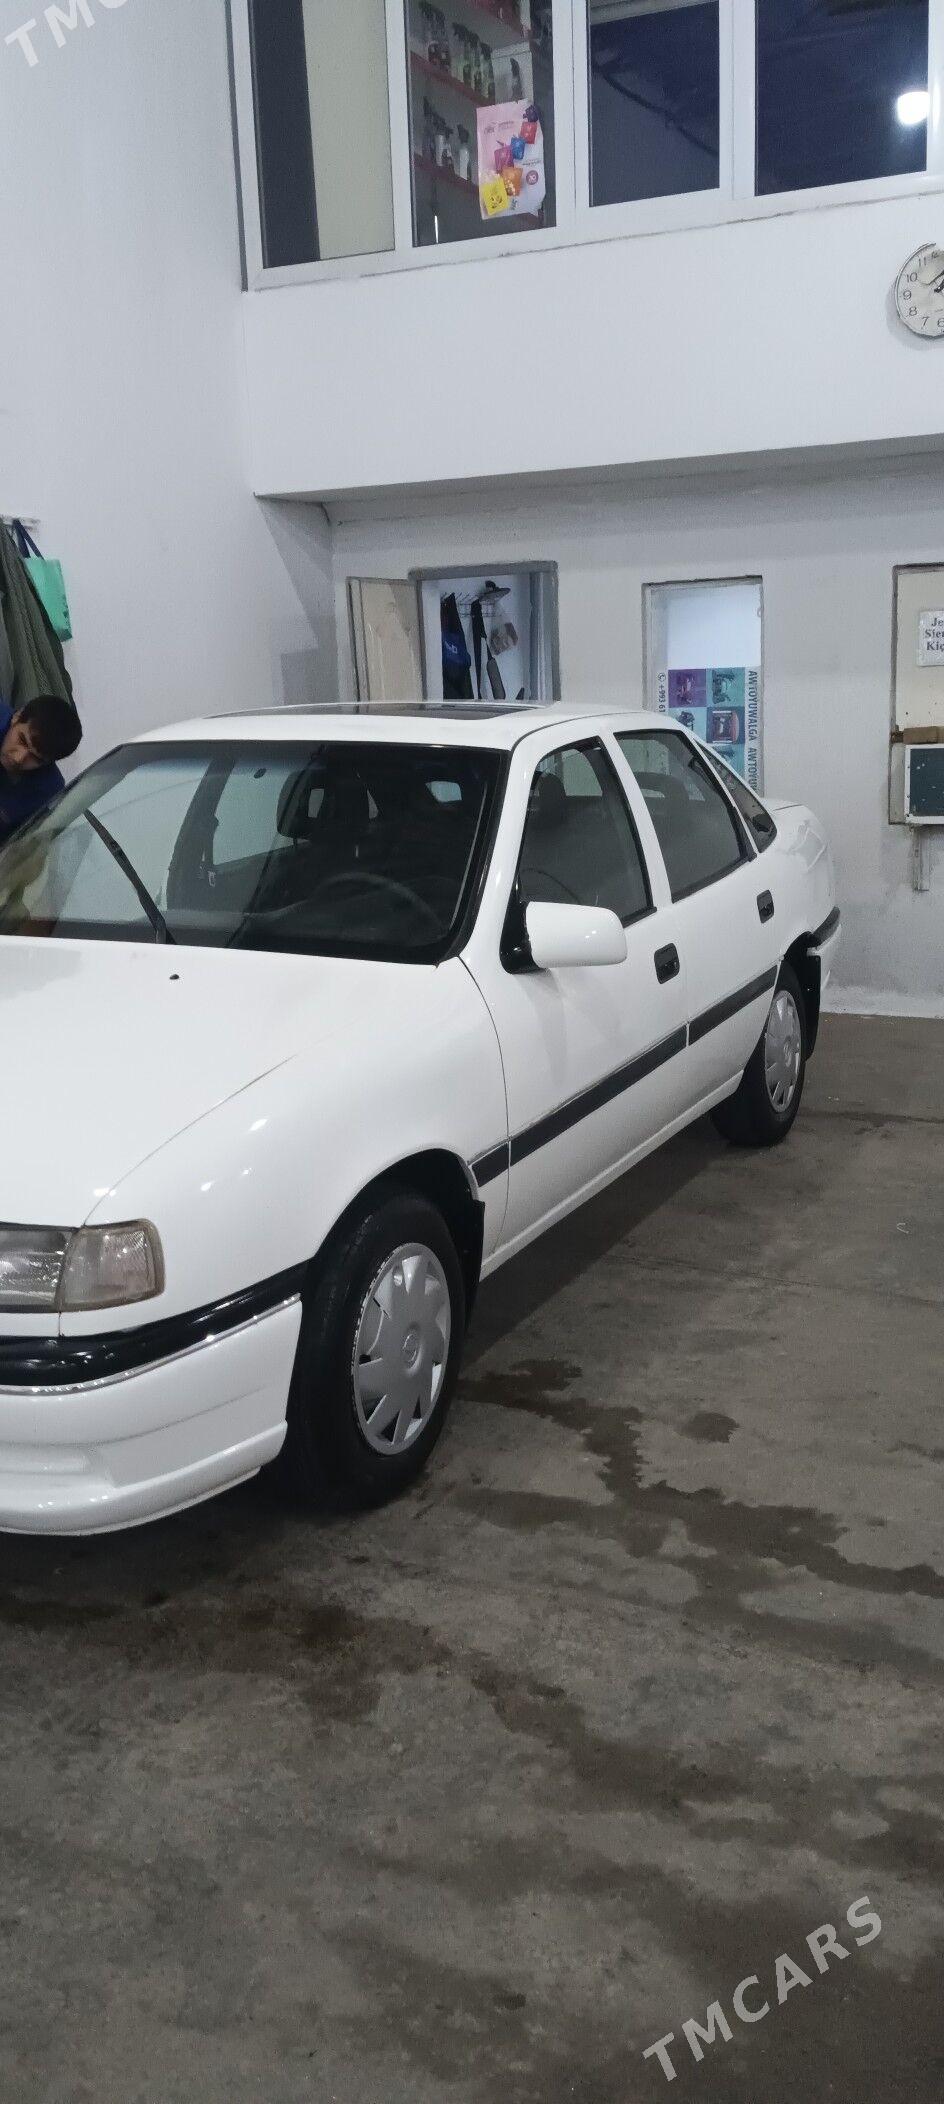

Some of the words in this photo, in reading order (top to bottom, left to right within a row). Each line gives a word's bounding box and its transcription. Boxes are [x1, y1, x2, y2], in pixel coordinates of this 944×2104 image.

[907, 272, 917, 282] 10
[903, 290, 911, 300] 9
[909, 306, 917, 316] 8
[921, 316, 929, 329] 7
[937, 317, 944, 328] 6
[658, 684, 666, 703] +993
[748, 670, 758, 742] AWTOYUWALGA
